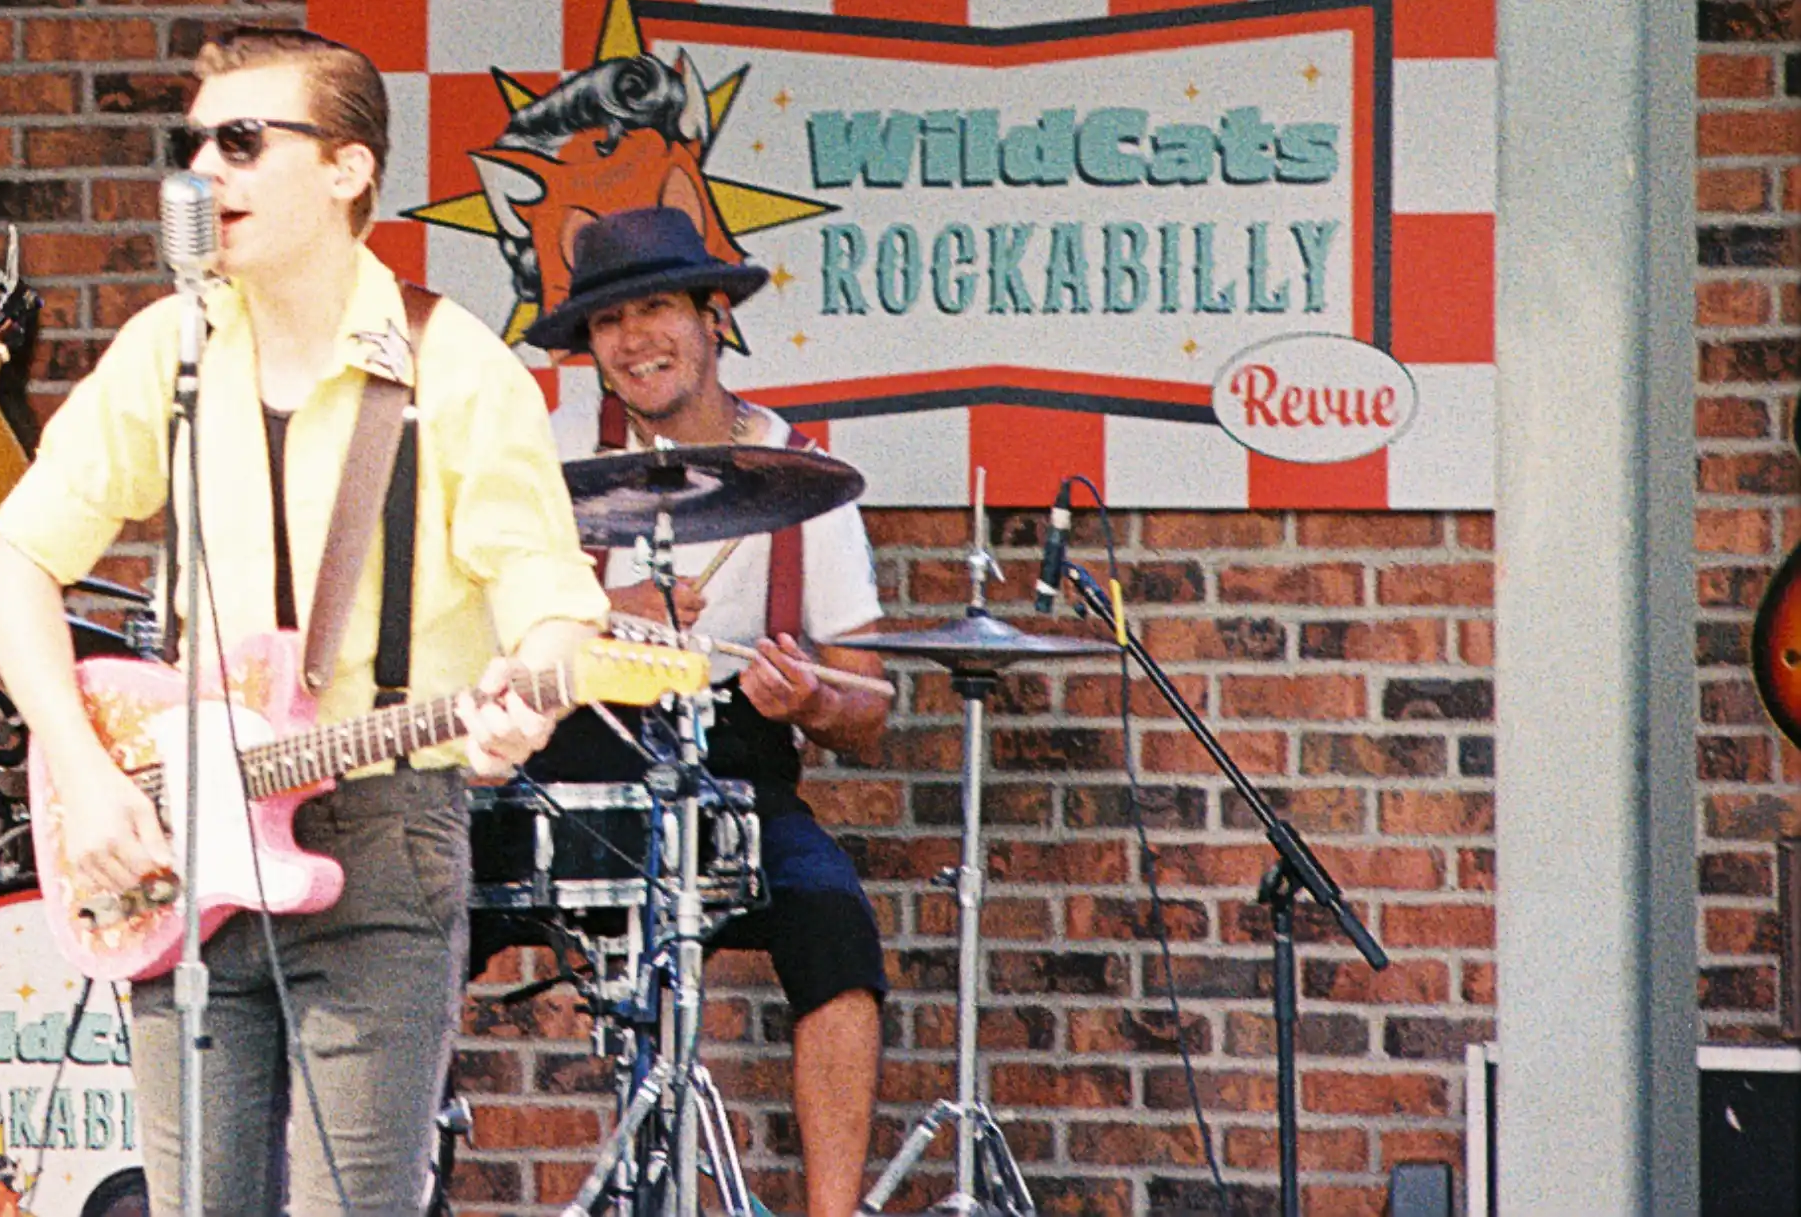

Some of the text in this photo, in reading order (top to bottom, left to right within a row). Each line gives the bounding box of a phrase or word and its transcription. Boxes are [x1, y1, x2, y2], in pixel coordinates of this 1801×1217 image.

[805, 104, 1341, 188] WildCats
[818, 218, 1341, 316] ROCKABILLY
[1228, 362, 1398, 428] Revue
